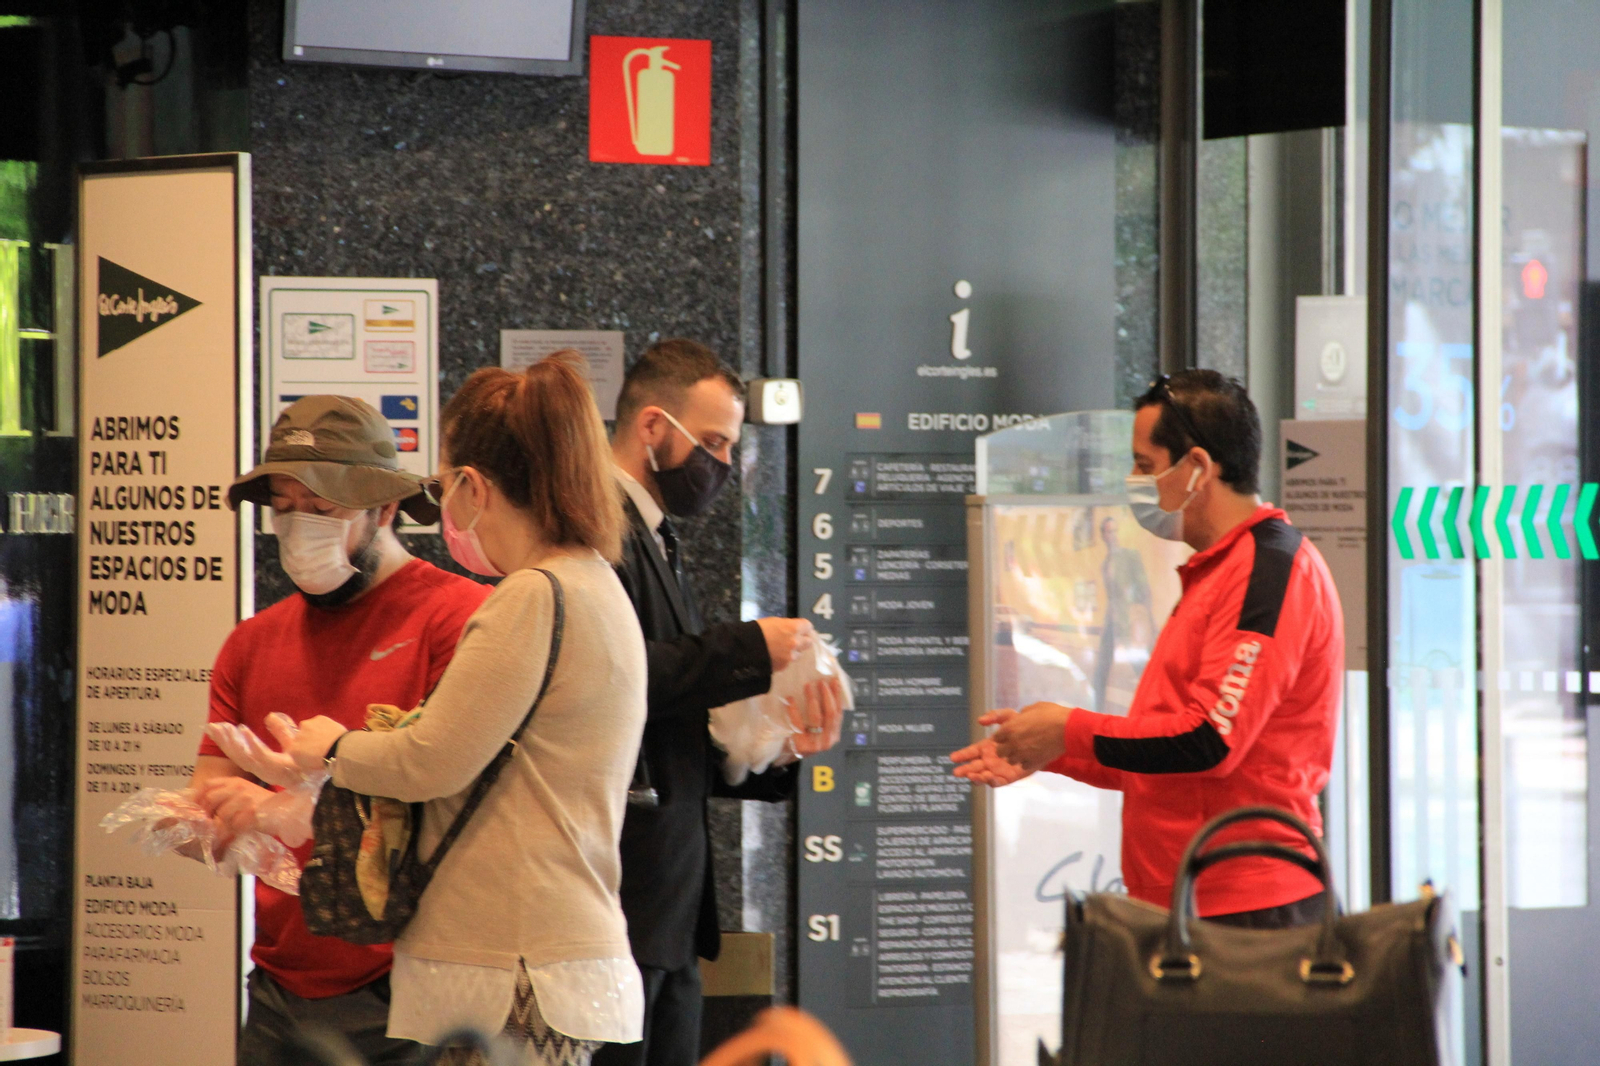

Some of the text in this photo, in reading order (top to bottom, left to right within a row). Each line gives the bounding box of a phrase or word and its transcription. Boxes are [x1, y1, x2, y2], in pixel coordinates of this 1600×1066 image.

[90, 415, 181, 441] ABRIMOS
[907, 412, 1052, 432] EDIFICIO MODA
[90, 451, 166, 475] PARA TI
[812, 467, 833, 495] 7
[90, 485, 221, 510] ALGUNOS DE
[89, 520, 196, 546] NUESTROS
[812, 513, 834, 541] 6
[89, 555, 223, 581] ESPACIOS DE
[813, 553, 834, 580] 5
[89, 590, 147, 615] MODA
[812, 592, 835, 620] 4
[86, 666, 142, 680] HORARIOS
[86, 685, 160, 700] DE APERTURA
[88, 721, 100, 733] DE
[87, 740, 100, 752] DE
[86, 763, 137, 776] DOMINGOS
[812, 766, 836, 793] B
[86, 781, 100, 793] DE
[805, 835, 844, 863] SS
[85, 874, 153, 889] PLANTA BAJA
[85, 899, 177, 916] EDIFICIO MODA
[84, 922, 204, 942] ACCESORIOS MODA
[808, 914, 840, 942] S1
[83, 969, 130, 987] BOLSOS
